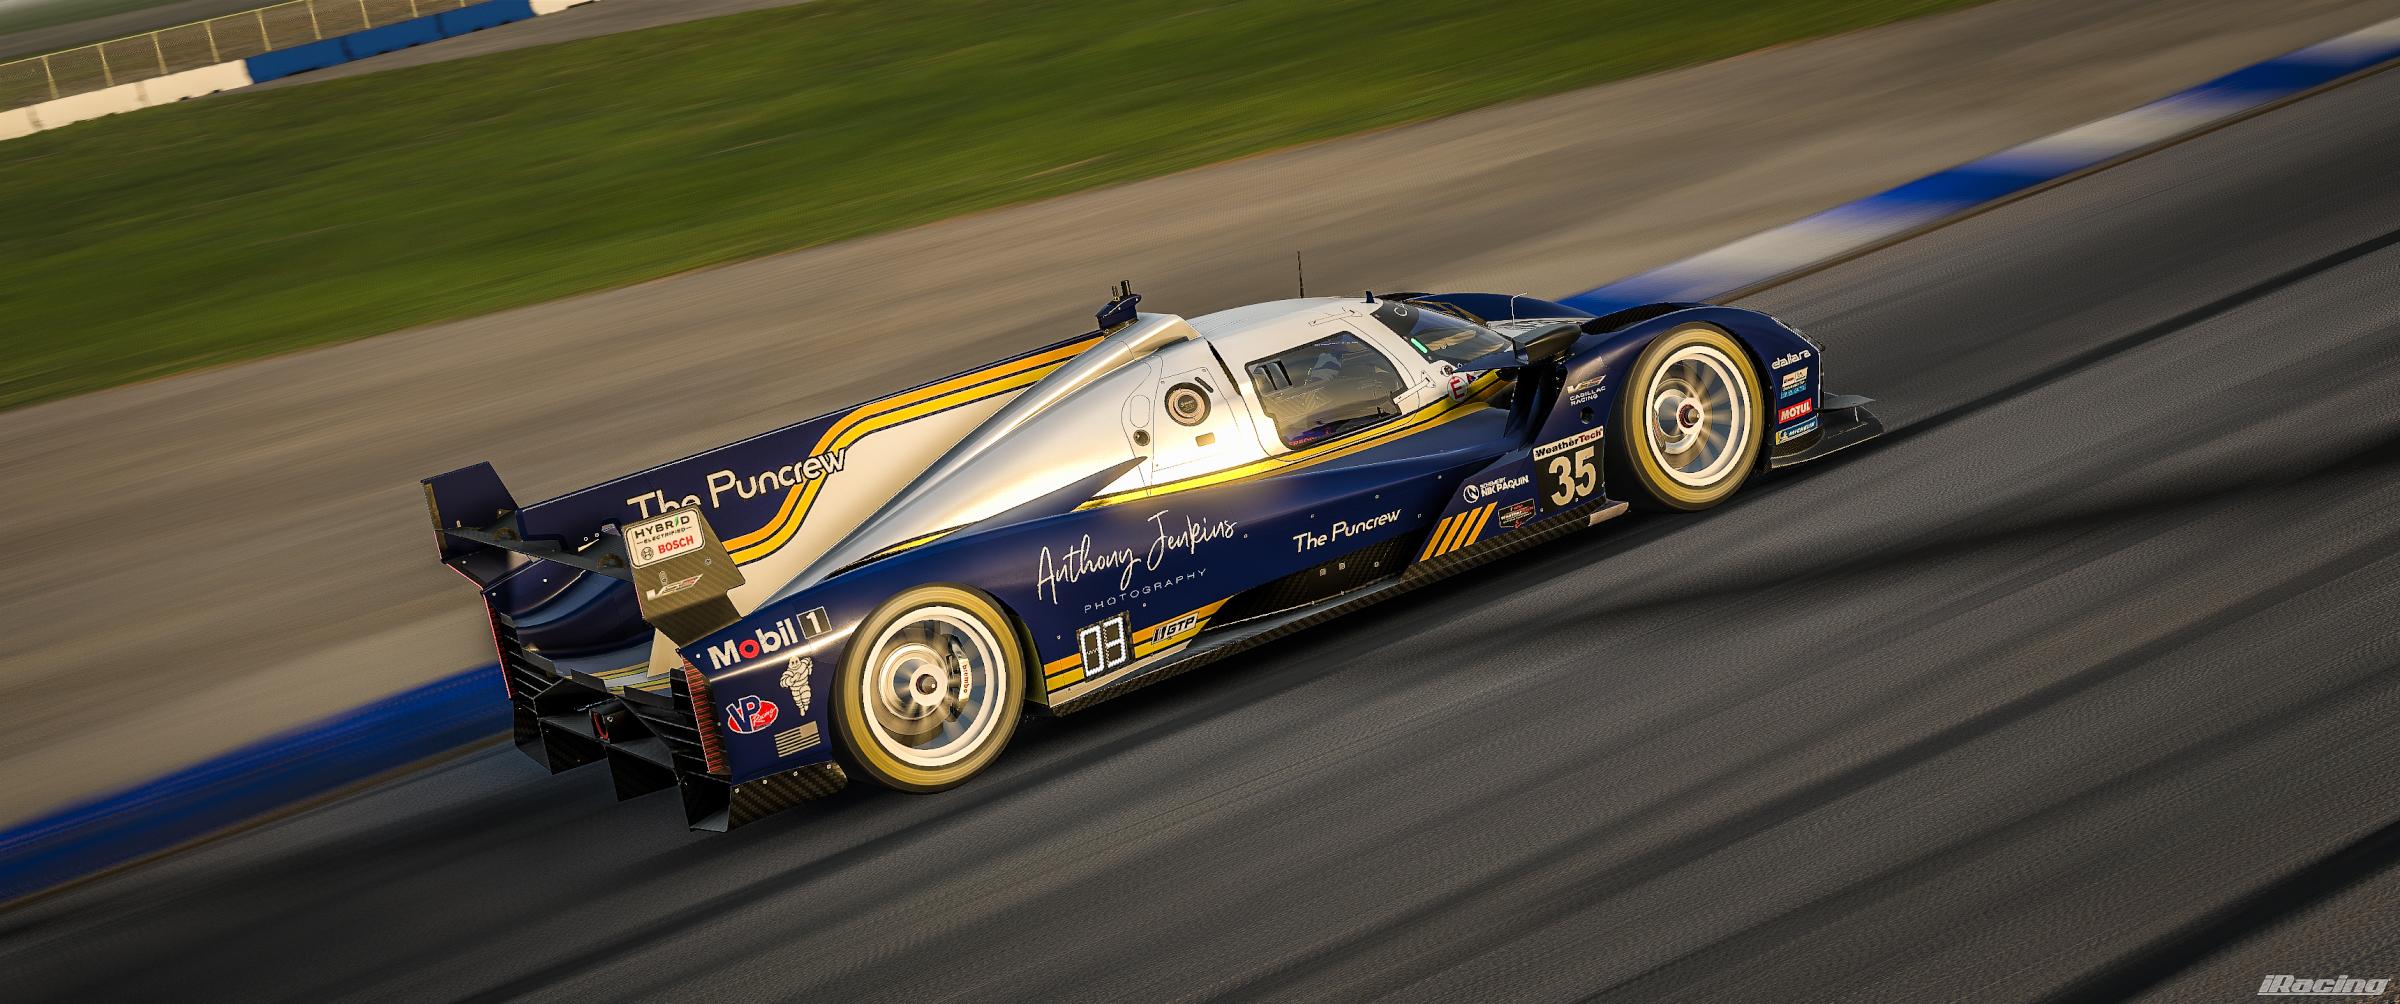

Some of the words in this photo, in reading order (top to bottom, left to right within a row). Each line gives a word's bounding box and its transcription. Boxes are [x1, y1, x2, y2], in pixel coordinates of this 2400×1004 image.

[1772, 350, 1811, 369] dallara
[1569, 386, 1606, 401] CADILLAC
[1570, 393, 1598, 406] RACING
[1781, 402, 1811, 420] MOTUL
[1535, 428, 1603, 458] WeatherTech
[706, 448, 846, 509] Puncrew
[1480, 486, 1497, 498] NIK
[1496, 474, 1530, 492] PAQUIN
[1548, 446, 1597, 506] 35
[657, 535, 694, 554] BOSCH
[1292, 531, 1328, 553] The
[1331, 508, 1402, 542] Puncrew
[1037, 534, 1141, 605] Anthony
[1146, 509, 1237, 571] Jenkins
[1084, 568, 1207, 614] PHOTOGRAPHY
[707, 617, 799, 670] Mobil
[805, 611, 822, 634] 1
[1166, 616, 1195, 636] GTP
[1079, 616, 1127, 677] 03
[725, 694, 762, 734] VP
